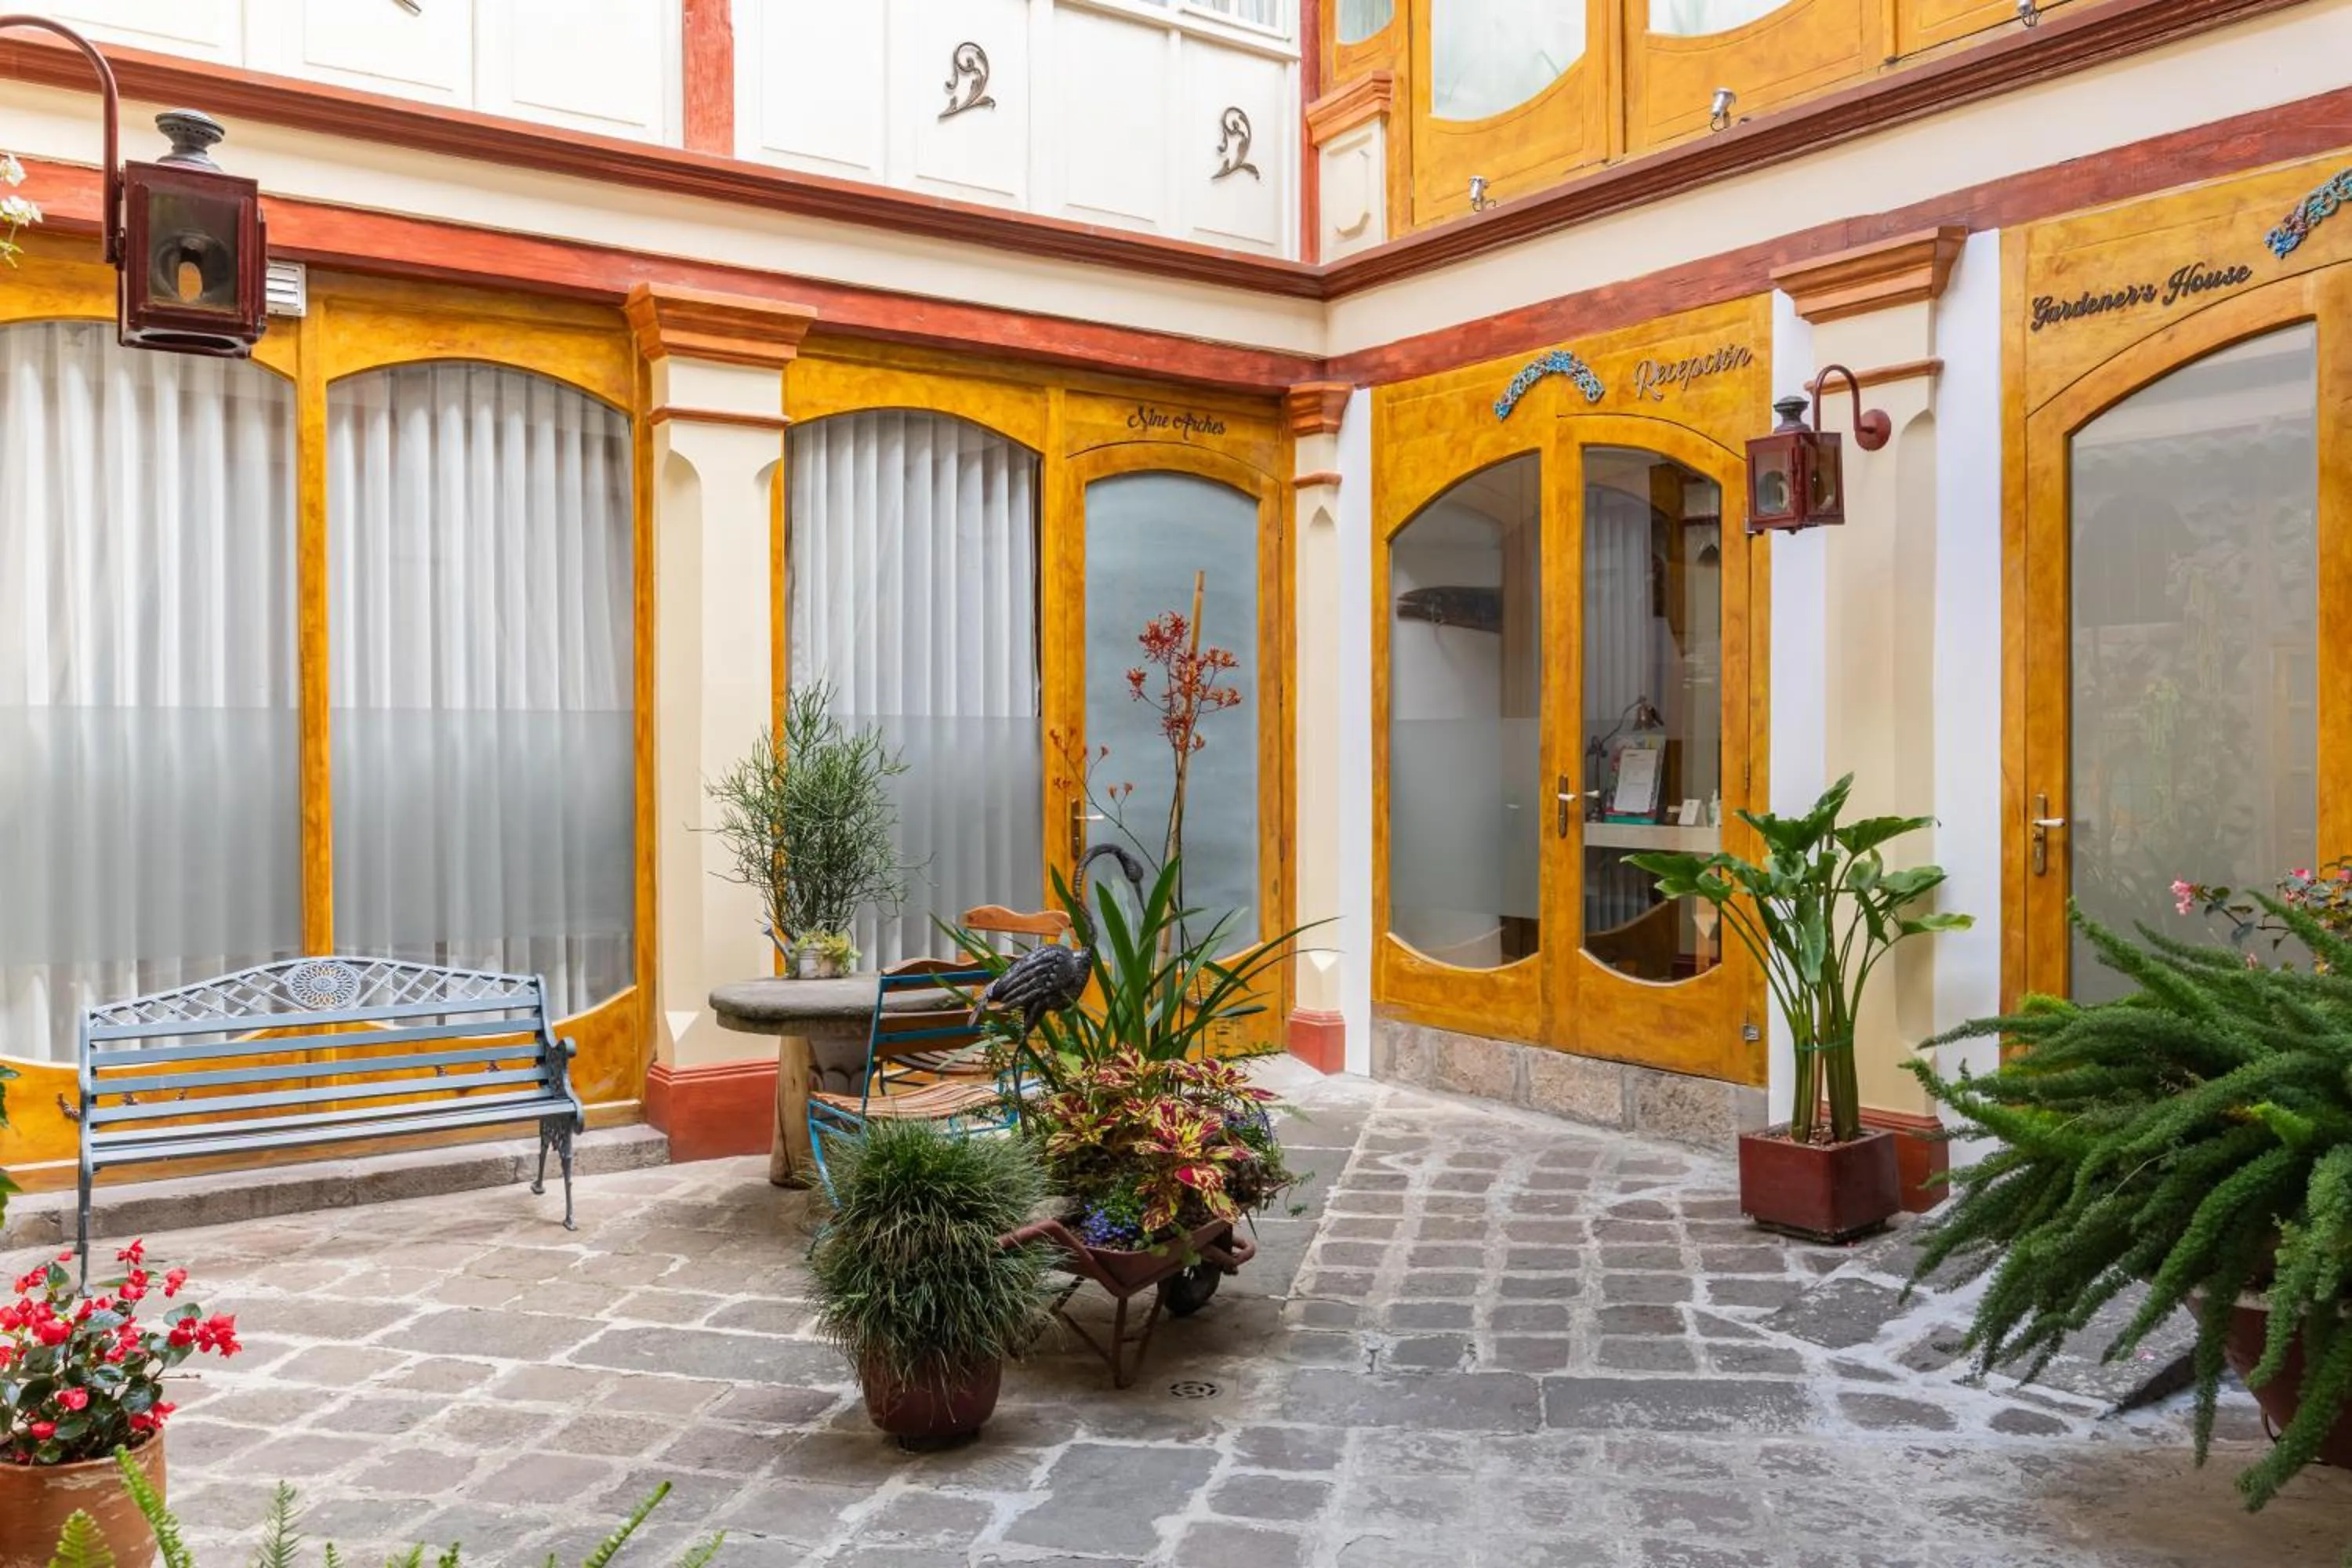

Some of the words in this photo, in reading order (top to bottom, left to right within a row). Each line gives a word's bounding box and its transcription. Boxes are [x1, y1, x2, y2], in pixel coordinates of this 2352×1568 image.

[2031, 284, 2157, 332] Gardener's
[2162, 261, 2252, 306] House
[1635, 343, 1753, 401] Recepción
[1127, 405, 1169, 431] Nine
[1172, 412, 1226, 441] Arches
